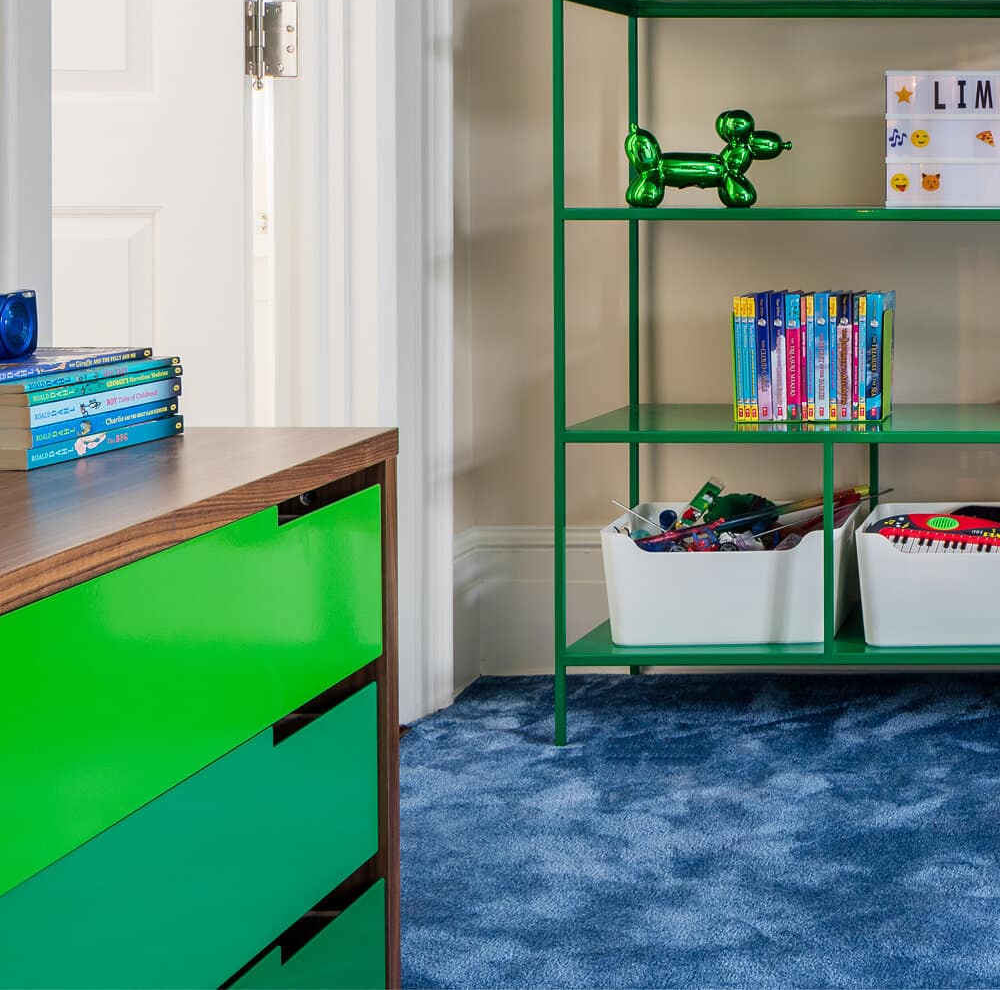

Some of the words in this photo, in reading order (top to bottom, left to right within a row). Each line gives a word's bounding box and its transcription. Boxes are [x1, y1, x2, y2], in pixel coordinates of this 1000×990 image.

[32, 394, 50, 402] ROALD
[50, 389, 75, 398] DAHL
[51, 407, 75, 416] DAHL
[36, 433, 51, 441] ROALD
[52, 427, 75, 437] DAHL
[106, 416, 124, 425] Charlie
[32, 453, 48, 462] ROALD
[49, 447, 74, 457] DAHL
[116, 432, 128, 442] BFG
